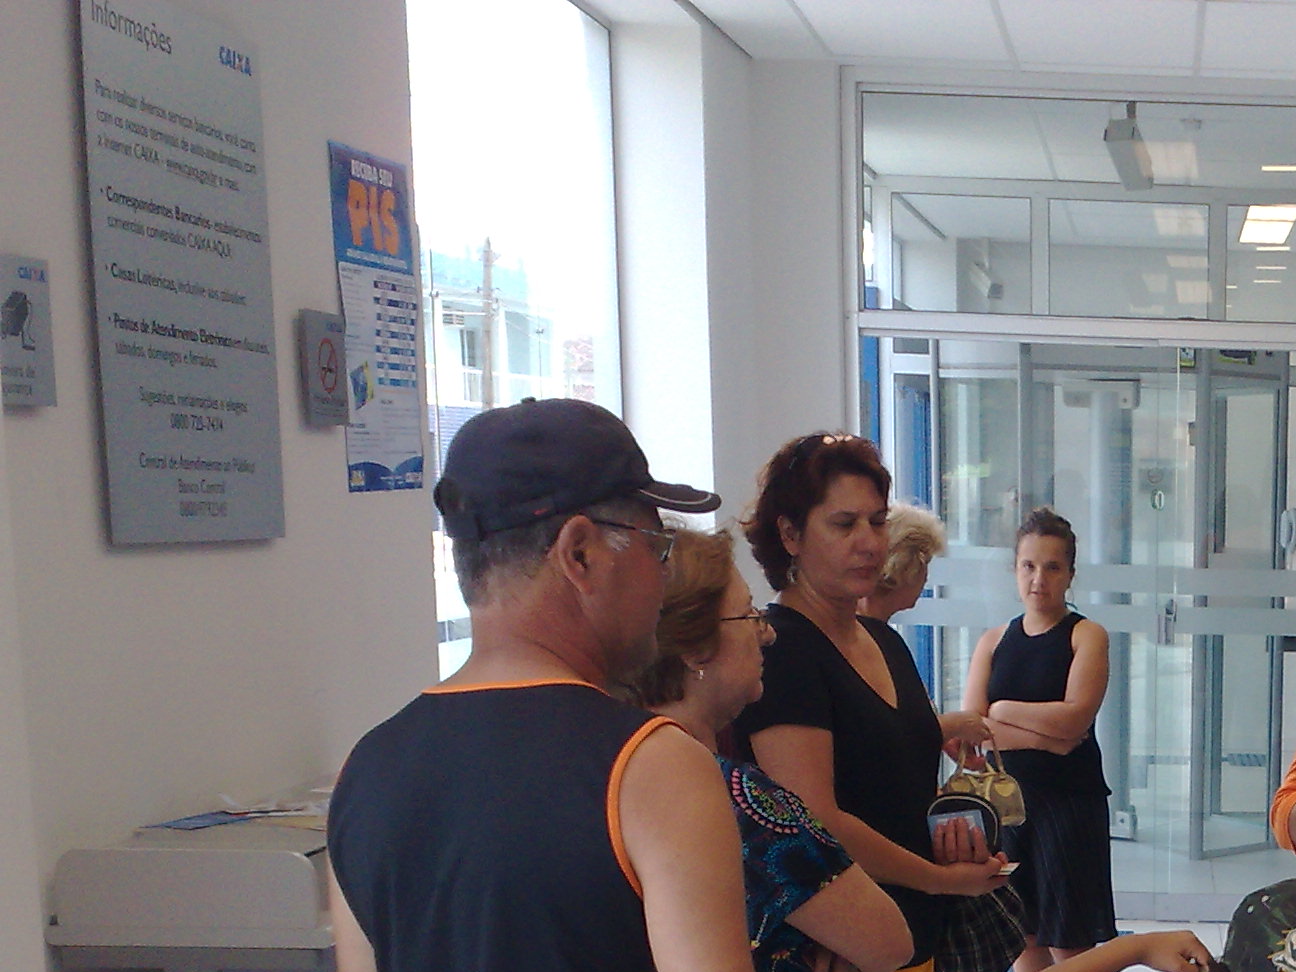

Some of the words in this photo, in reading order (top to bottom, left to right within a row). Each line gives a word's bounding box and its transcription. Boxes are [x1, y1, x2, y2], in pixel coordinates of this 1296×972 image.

[91, 0, 172, 54] Informações
[219, 46, 252, 76] CAIXA
[347, 178, 399, 257] PIS
